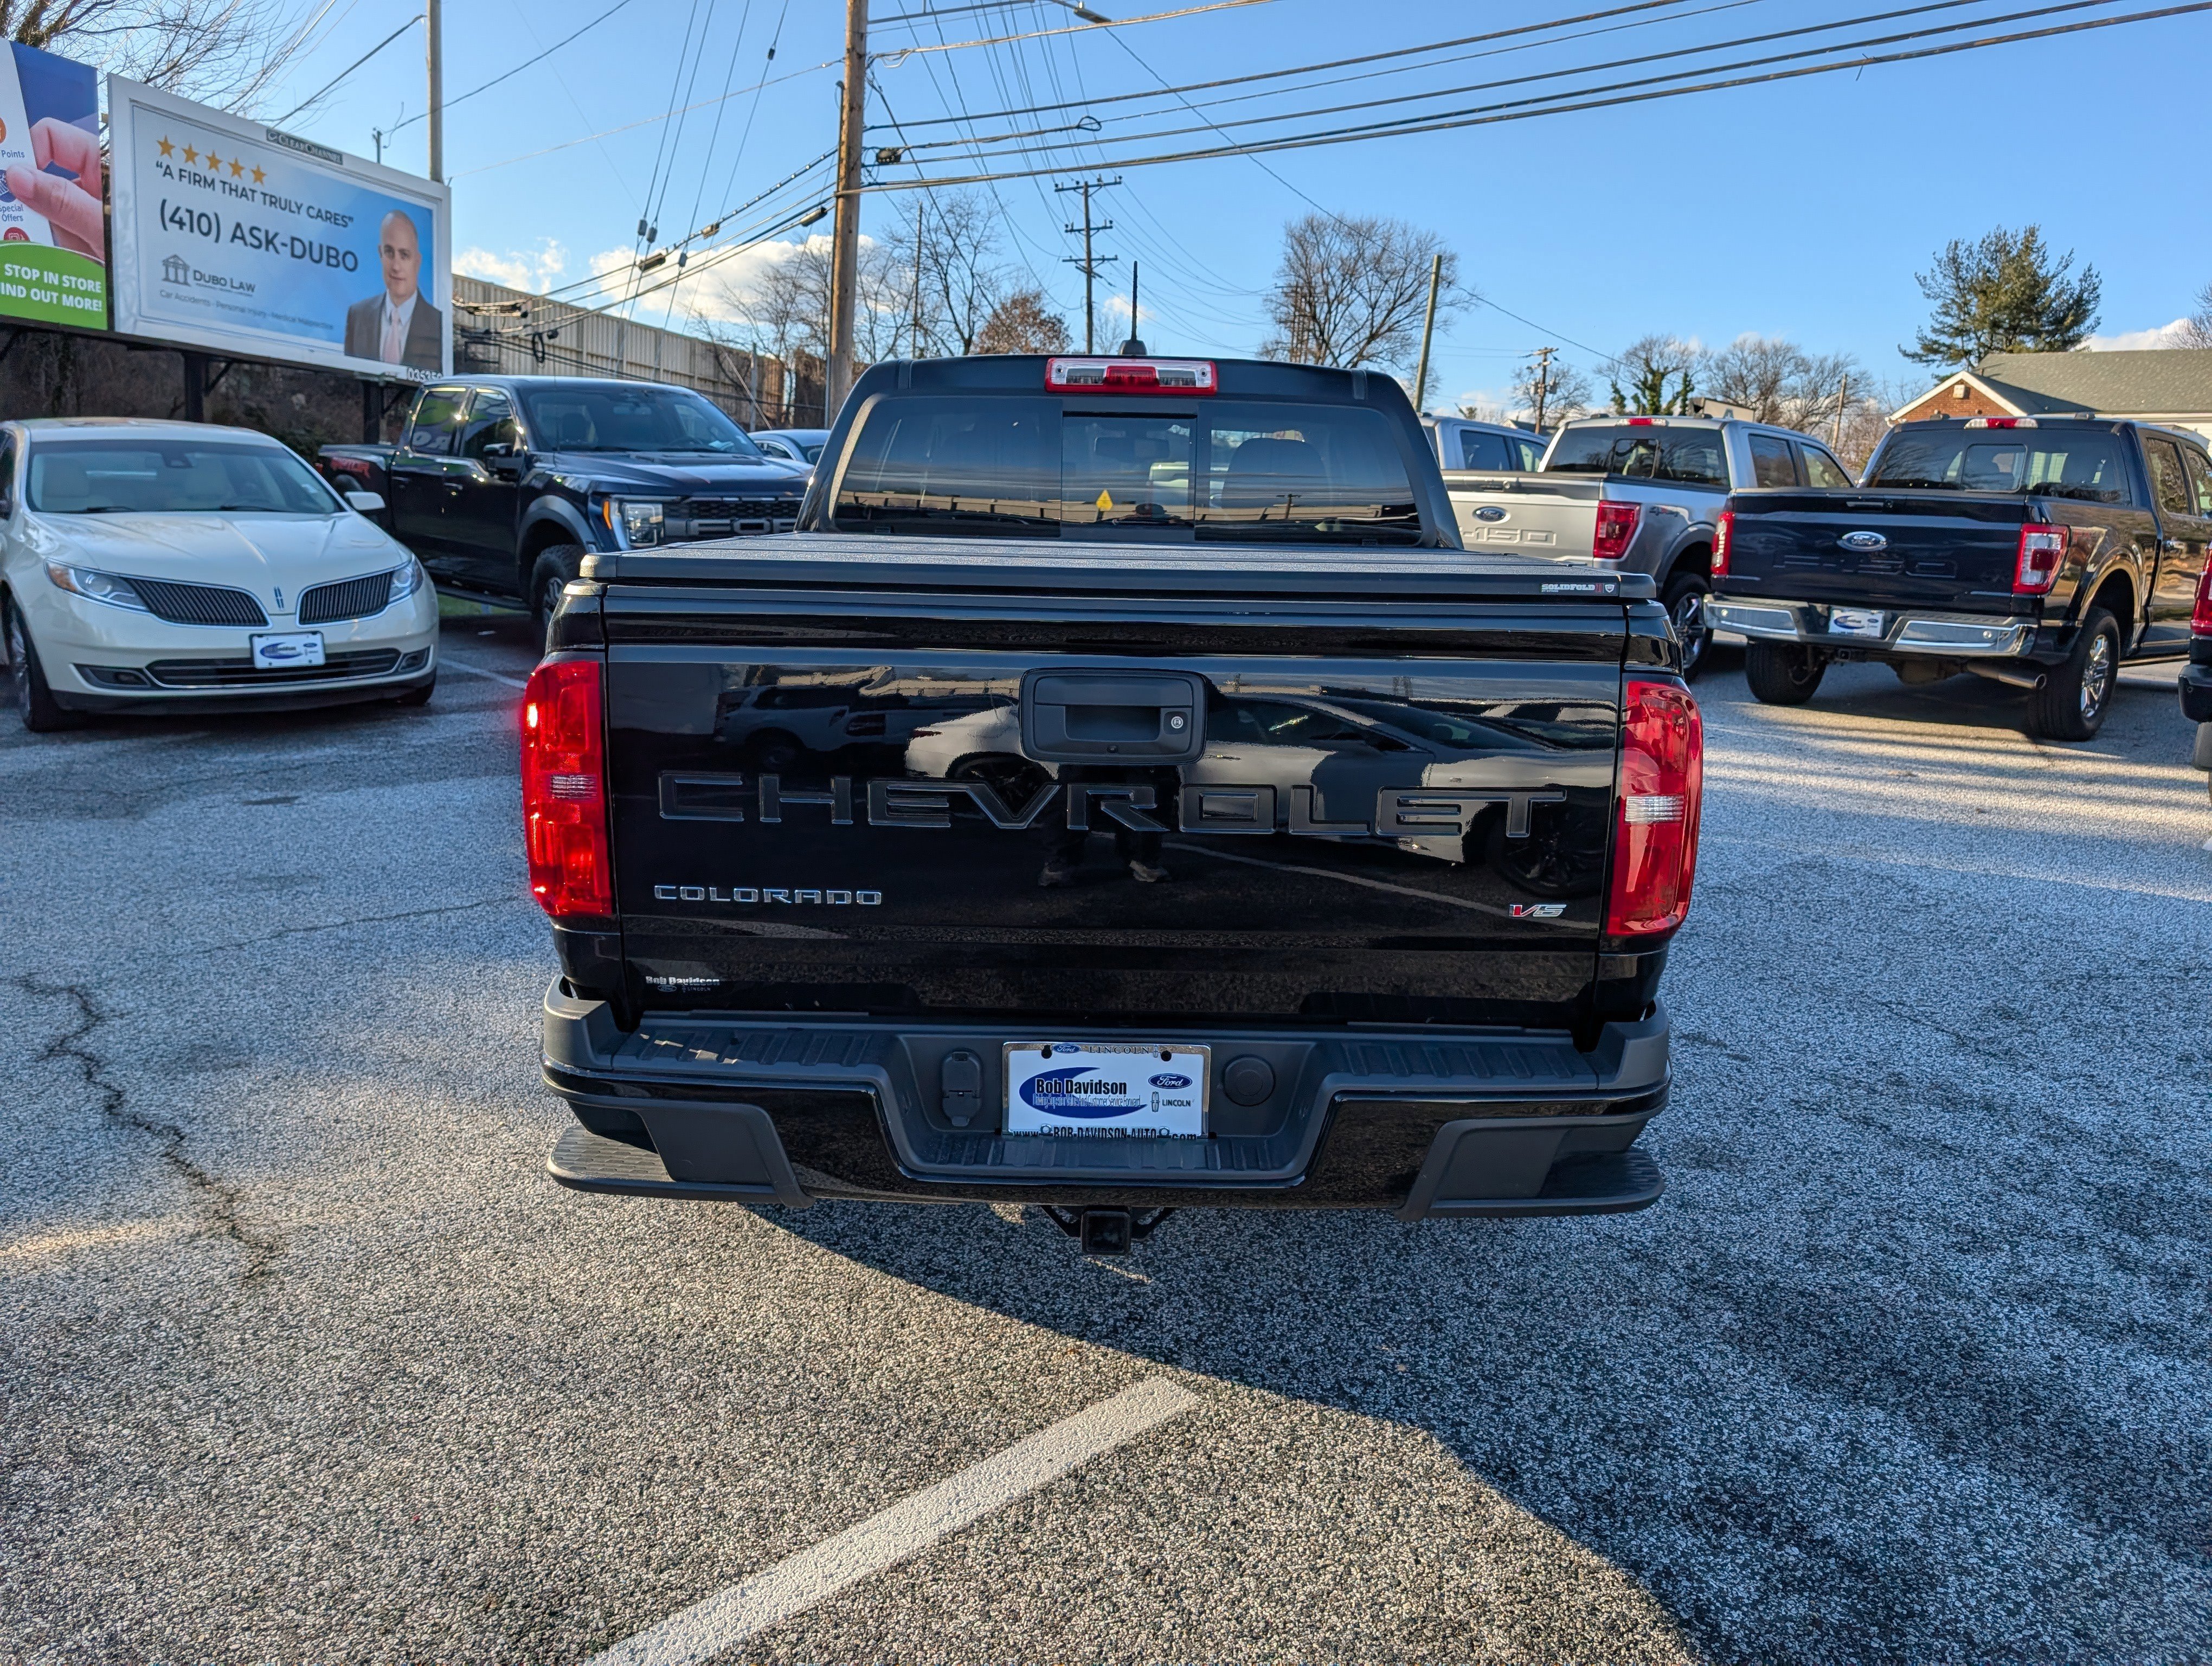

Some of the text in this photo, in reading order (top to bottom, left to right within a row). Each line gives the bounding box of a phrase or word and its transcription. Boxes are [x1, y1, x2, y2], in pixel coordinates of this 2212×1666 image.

[179, 169, 215, 191] FIRM
[220, 180, 258, 203] THAT
[260, 191, 303, 215] TRULY
[2, 214, 23, 222] Offers
[160, 198, 359, 272] (410) ASK-DUBO
[4, 263, 101, 293] STOP IN STORE
[0, 282, 102, 312] IND OUT MORE!
[1458, 526, 1557, 546] -150
[658, 772, 1567, 837] CHEVROLET
[654, 885, 883, 905] COLORADO
[1508, 904, 1567, 917] V6
[645, 976, 720, 986] Bob Davidson
[1088, 1046, 1150, 1054] LINCOLN
[1035, 1078, 1127, 1095] Bob Davidson
[1156, 1075, 1184, 1087] Ford
[1161, 1099, 1191, 1107] LINCOLN
